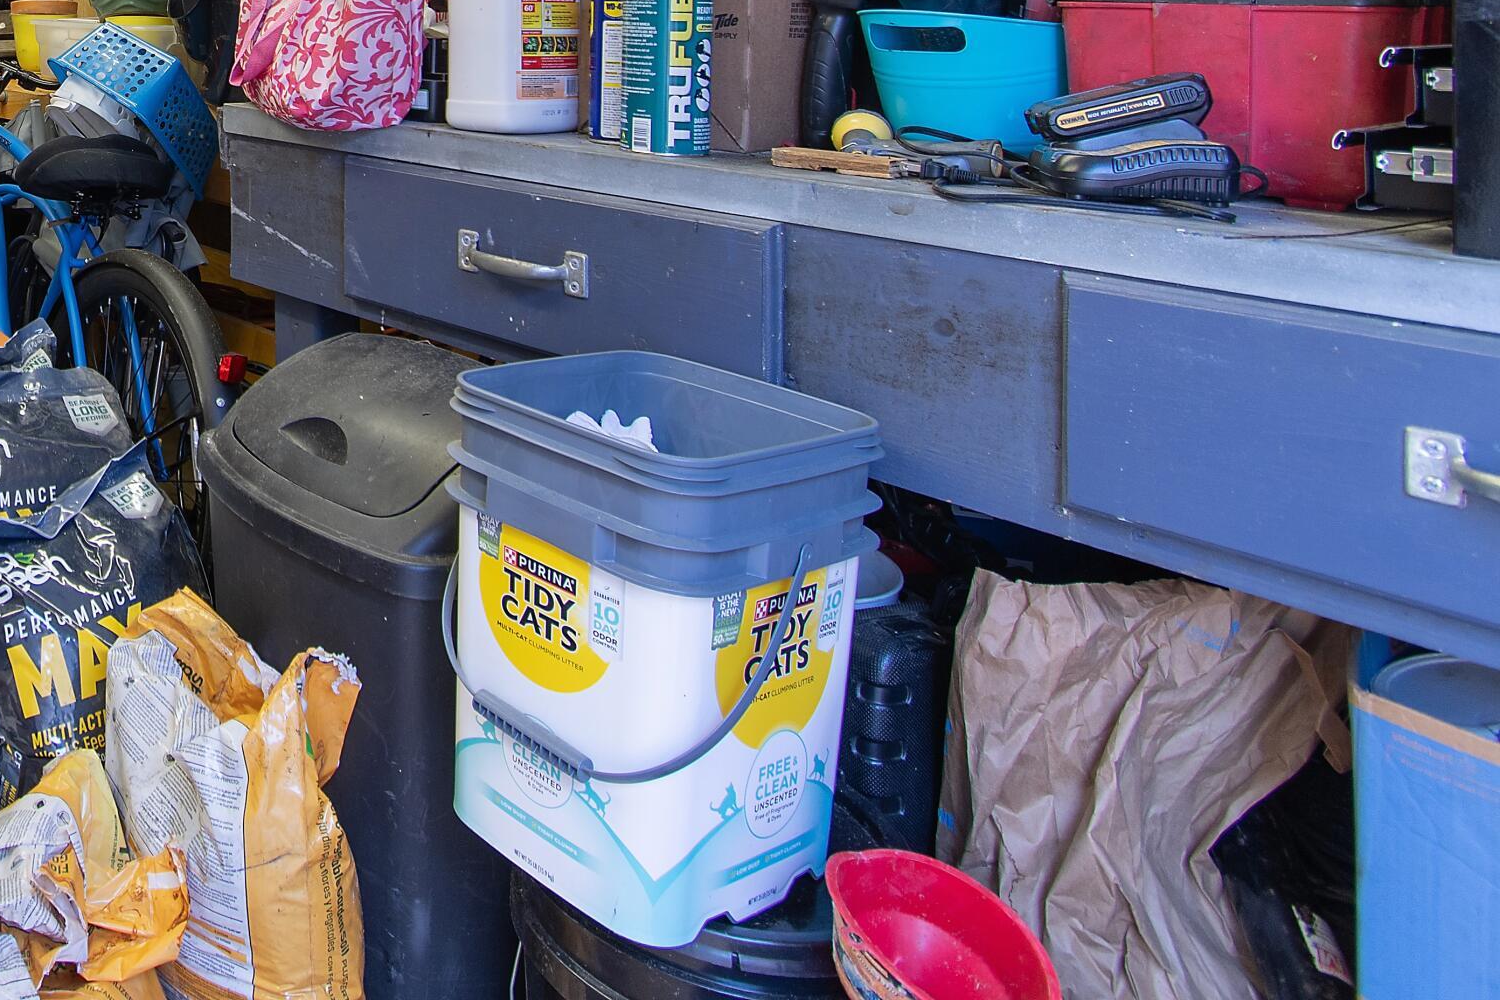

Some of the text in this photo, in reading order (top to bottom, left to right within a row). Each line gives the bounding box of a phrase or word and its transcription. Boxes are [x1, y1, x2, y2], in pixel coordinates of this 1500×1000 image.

[714, 13, 739, 30] Tide
[714, 32, 738, 40] SIMPLY
[1100, 105, 1128, 116] LITHIUM
[71, 405, 109, 418] LONG
[518, 555, 575, 592] PURINA
[503, 567, 576, 622] TIDY
[726, 599, 739, 609] THE
[769, 588, 816, 613] PUNA
[823, 590, 842, 612] 10
[501, 594, 578, 652] CATS
[594, 601, 620, 626] 10
[721, 608, 737, 618] NEW
[822, 610, 839, 624] DAY
[593, 620, 618, 637] DAY
[818, 630, 836, 639] CONTROL
[819, 621, 837, 633] ODOR
[497, 620, 584, 672] MULTI-CAT CLUMPING LITTER
[593, 630, 618, 647] ODOR
[593, 637, 618, 653] CONTROL
[771, 675, 815, 697] CLUMPING LITTER
[32, 709, 107, 751] MULTI-ACTI
[83, 731, 107, 751] Fee
[512, 742, 561, 782] CLEAN
[512, 754, 562, 792] UNSCENTED
[758, 756, 791, 783] FREE
[530, 776, 559, 797] Fragrances
[532, 783, 545, 795] Dyes
[755, 770, 798, 801] CLEAN
[754, 787, 798, 814] UNSCENTED
[755, 812, 765, 822] Free
[770, 801, 795, 817] Fragrances
[771, 814, 782, 823] Dyes
[321, 870, 332, 898] flores
[336, 888, 346, 932] Garden
[325, 906, 336, 953] vegetales
[340, 932, 350, 957] Soil
